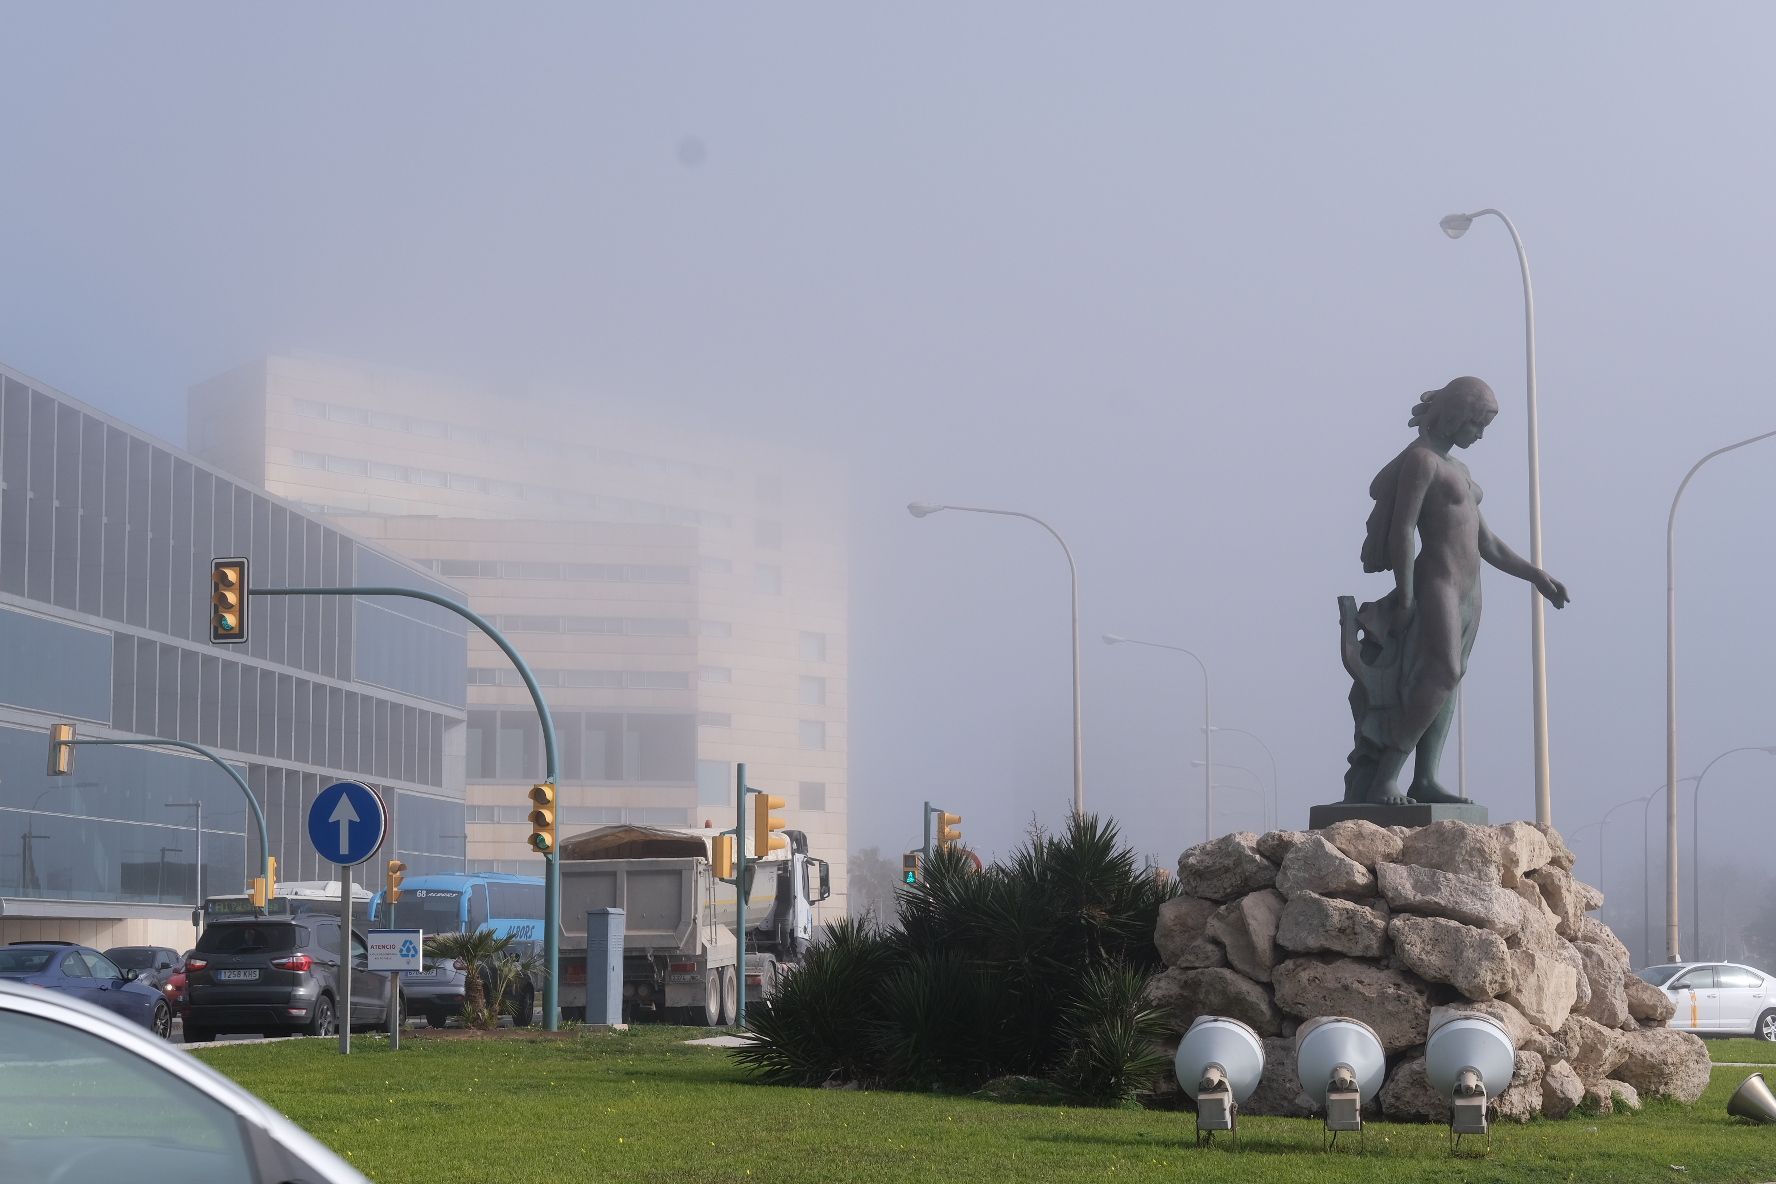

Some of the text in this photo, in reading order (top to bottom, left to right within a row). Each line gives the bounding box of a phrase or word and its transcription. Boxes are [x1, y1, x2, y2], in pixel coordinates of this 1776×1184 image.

[416, 889, 427, 898] 68
[224, 970, 258, 979] 1258 KHS
